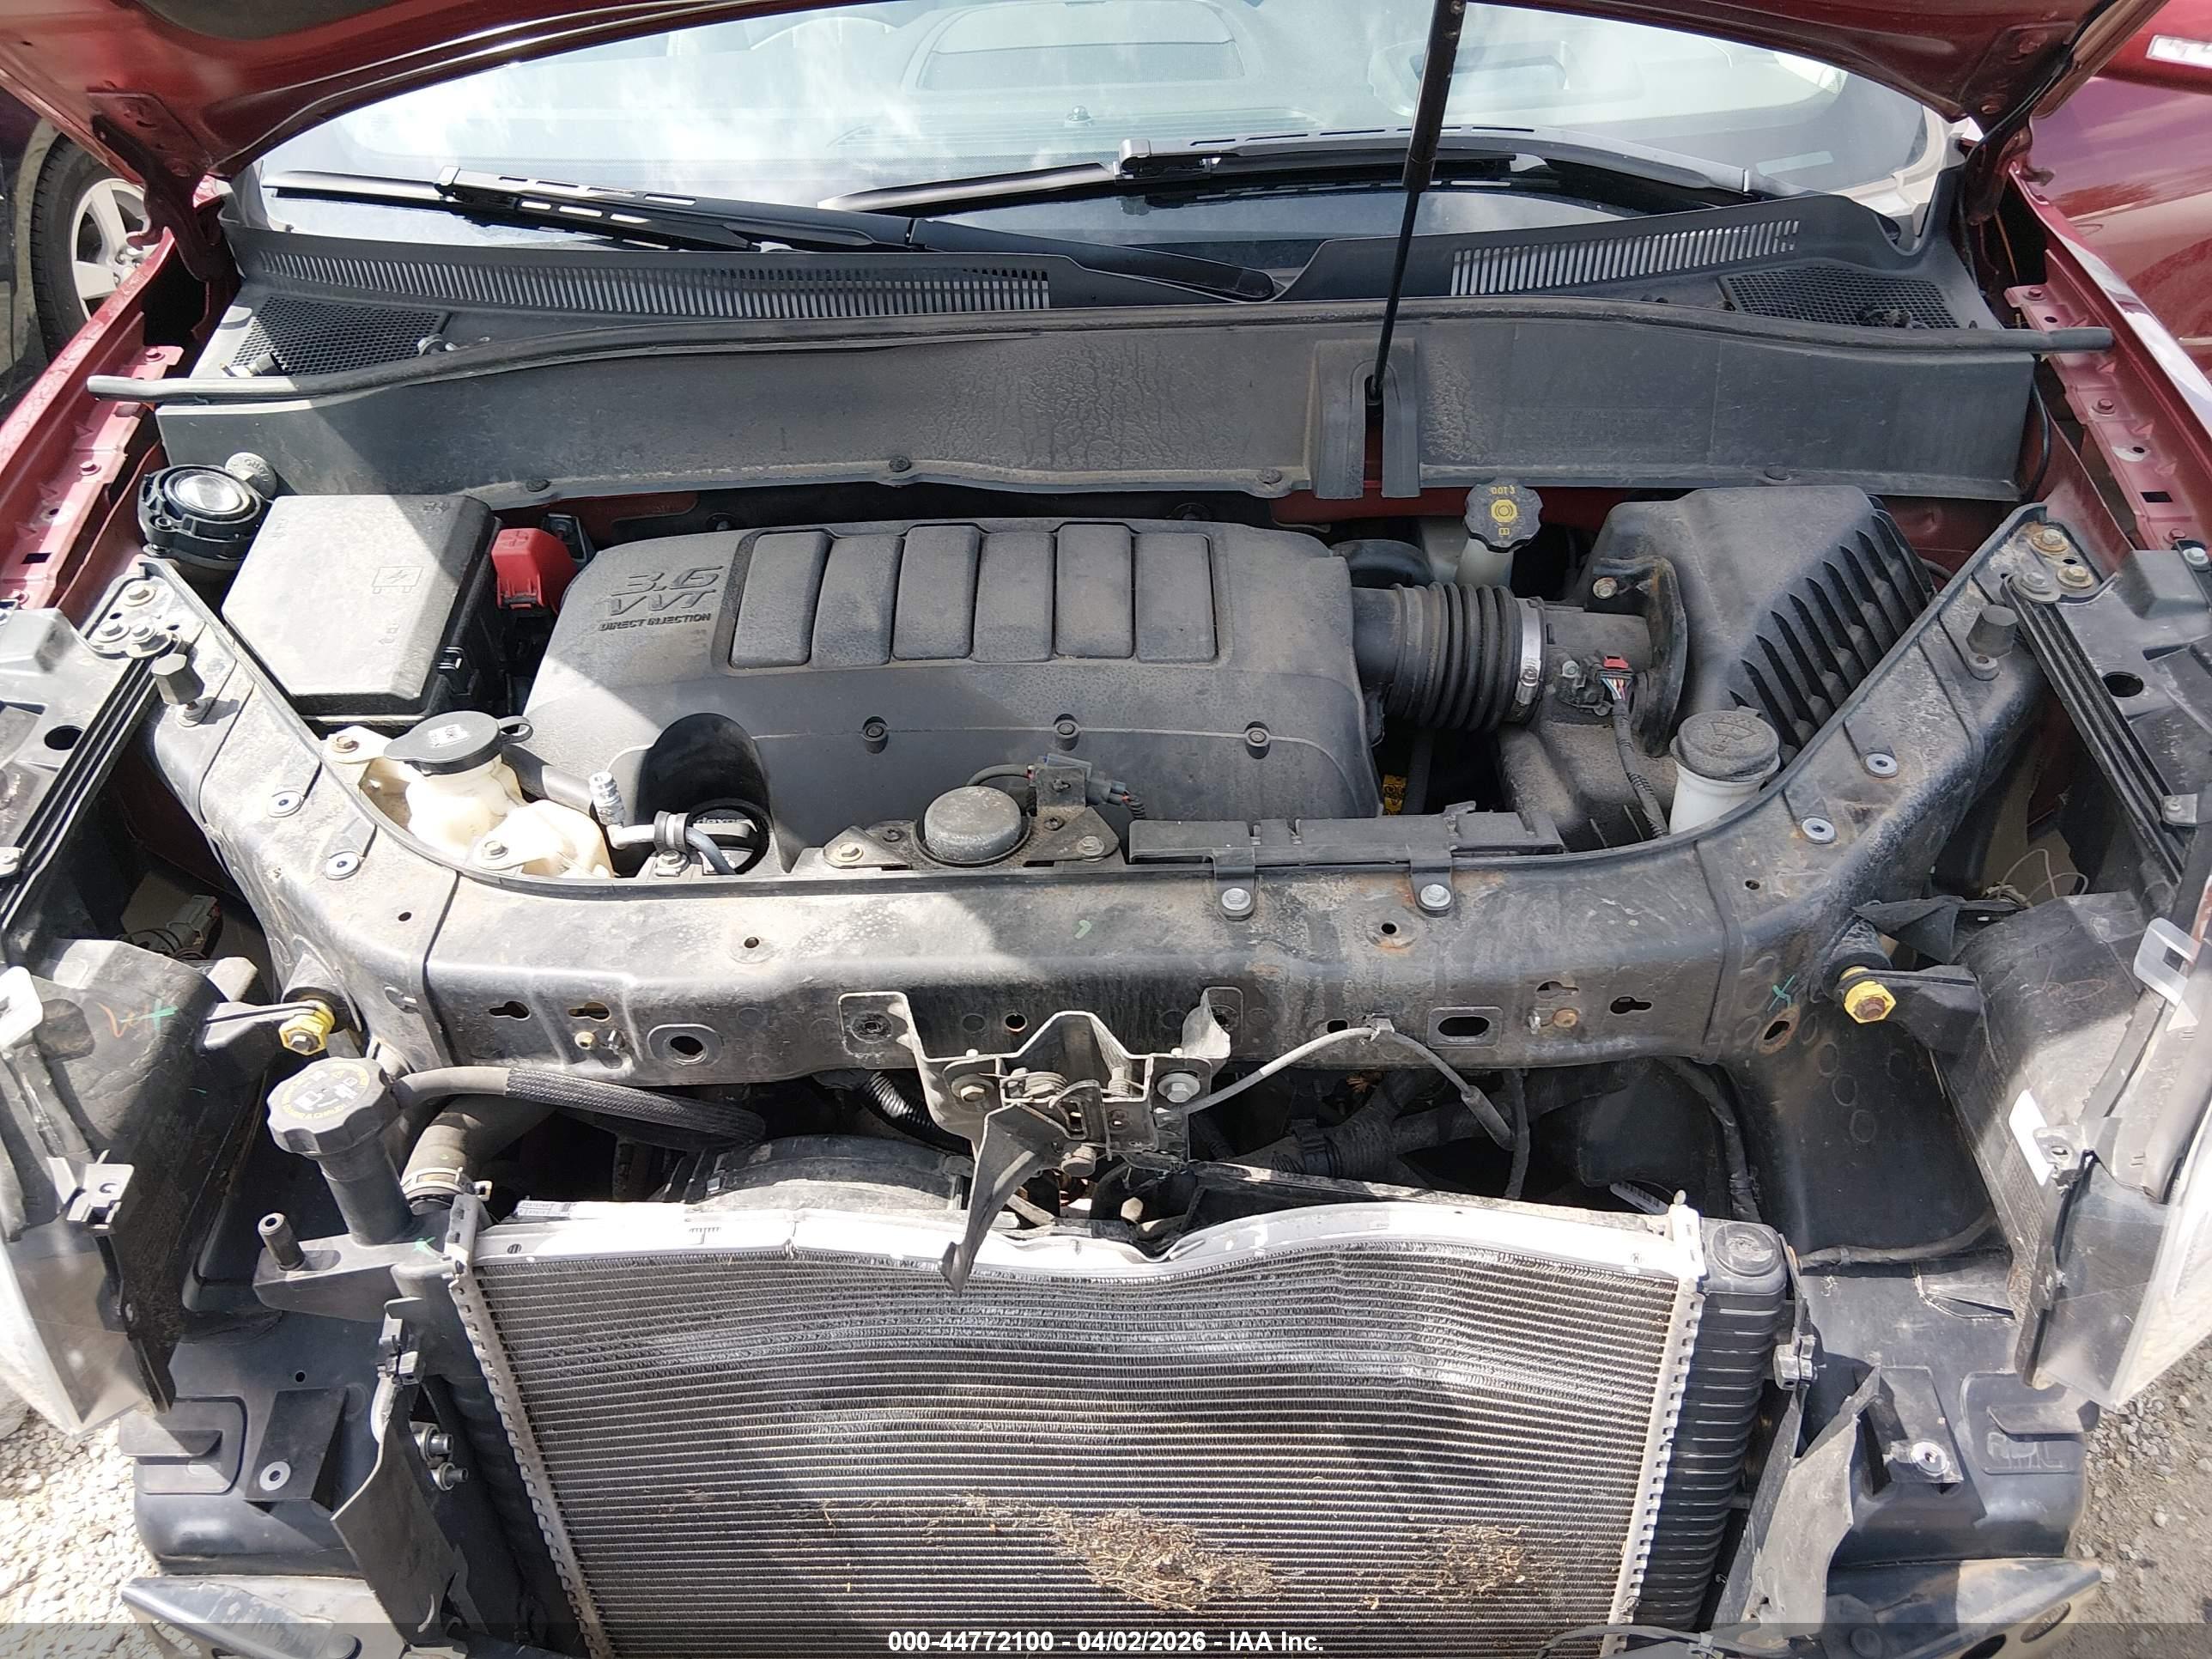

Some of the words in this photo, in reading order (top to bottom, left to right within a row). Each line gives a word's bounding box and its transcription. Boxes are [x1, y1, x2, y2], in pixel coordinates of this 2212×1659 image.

[611, 565, 724, 597] 3.6
[598, 589, 717, 617] VVT
[599, 618, 647, 631] DIRECT
[646, 612, 712, 626] INJECTION
